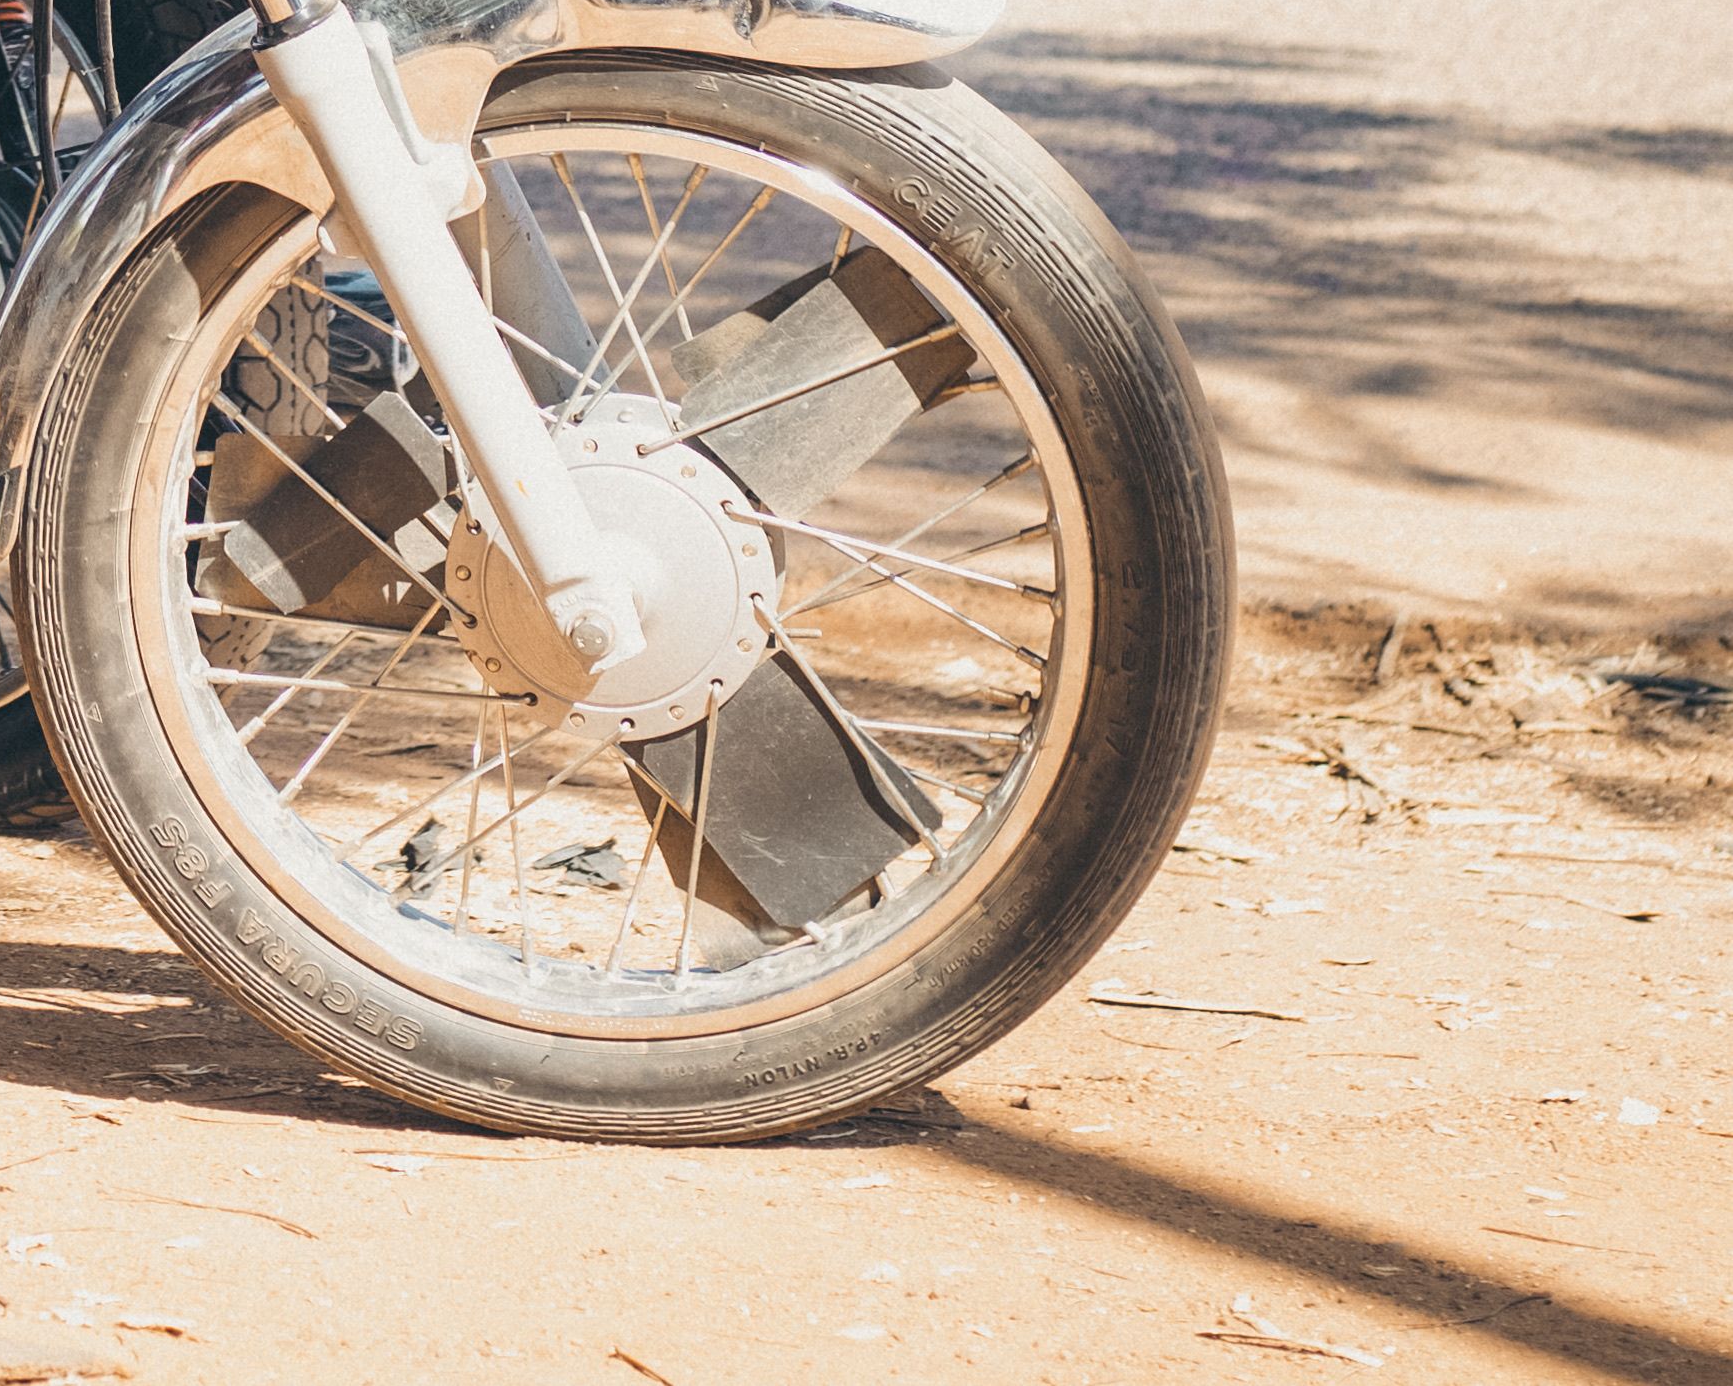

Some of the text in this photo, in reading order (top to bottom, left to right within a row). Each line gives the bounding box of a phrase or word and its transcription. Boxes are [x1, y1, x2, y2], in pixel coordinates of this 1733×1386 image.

[893, 174, 1017, 277] CEAT
[149, 817, 425, 1051] SECURA F85
[743, 1055, 823, 1089] NYLON
